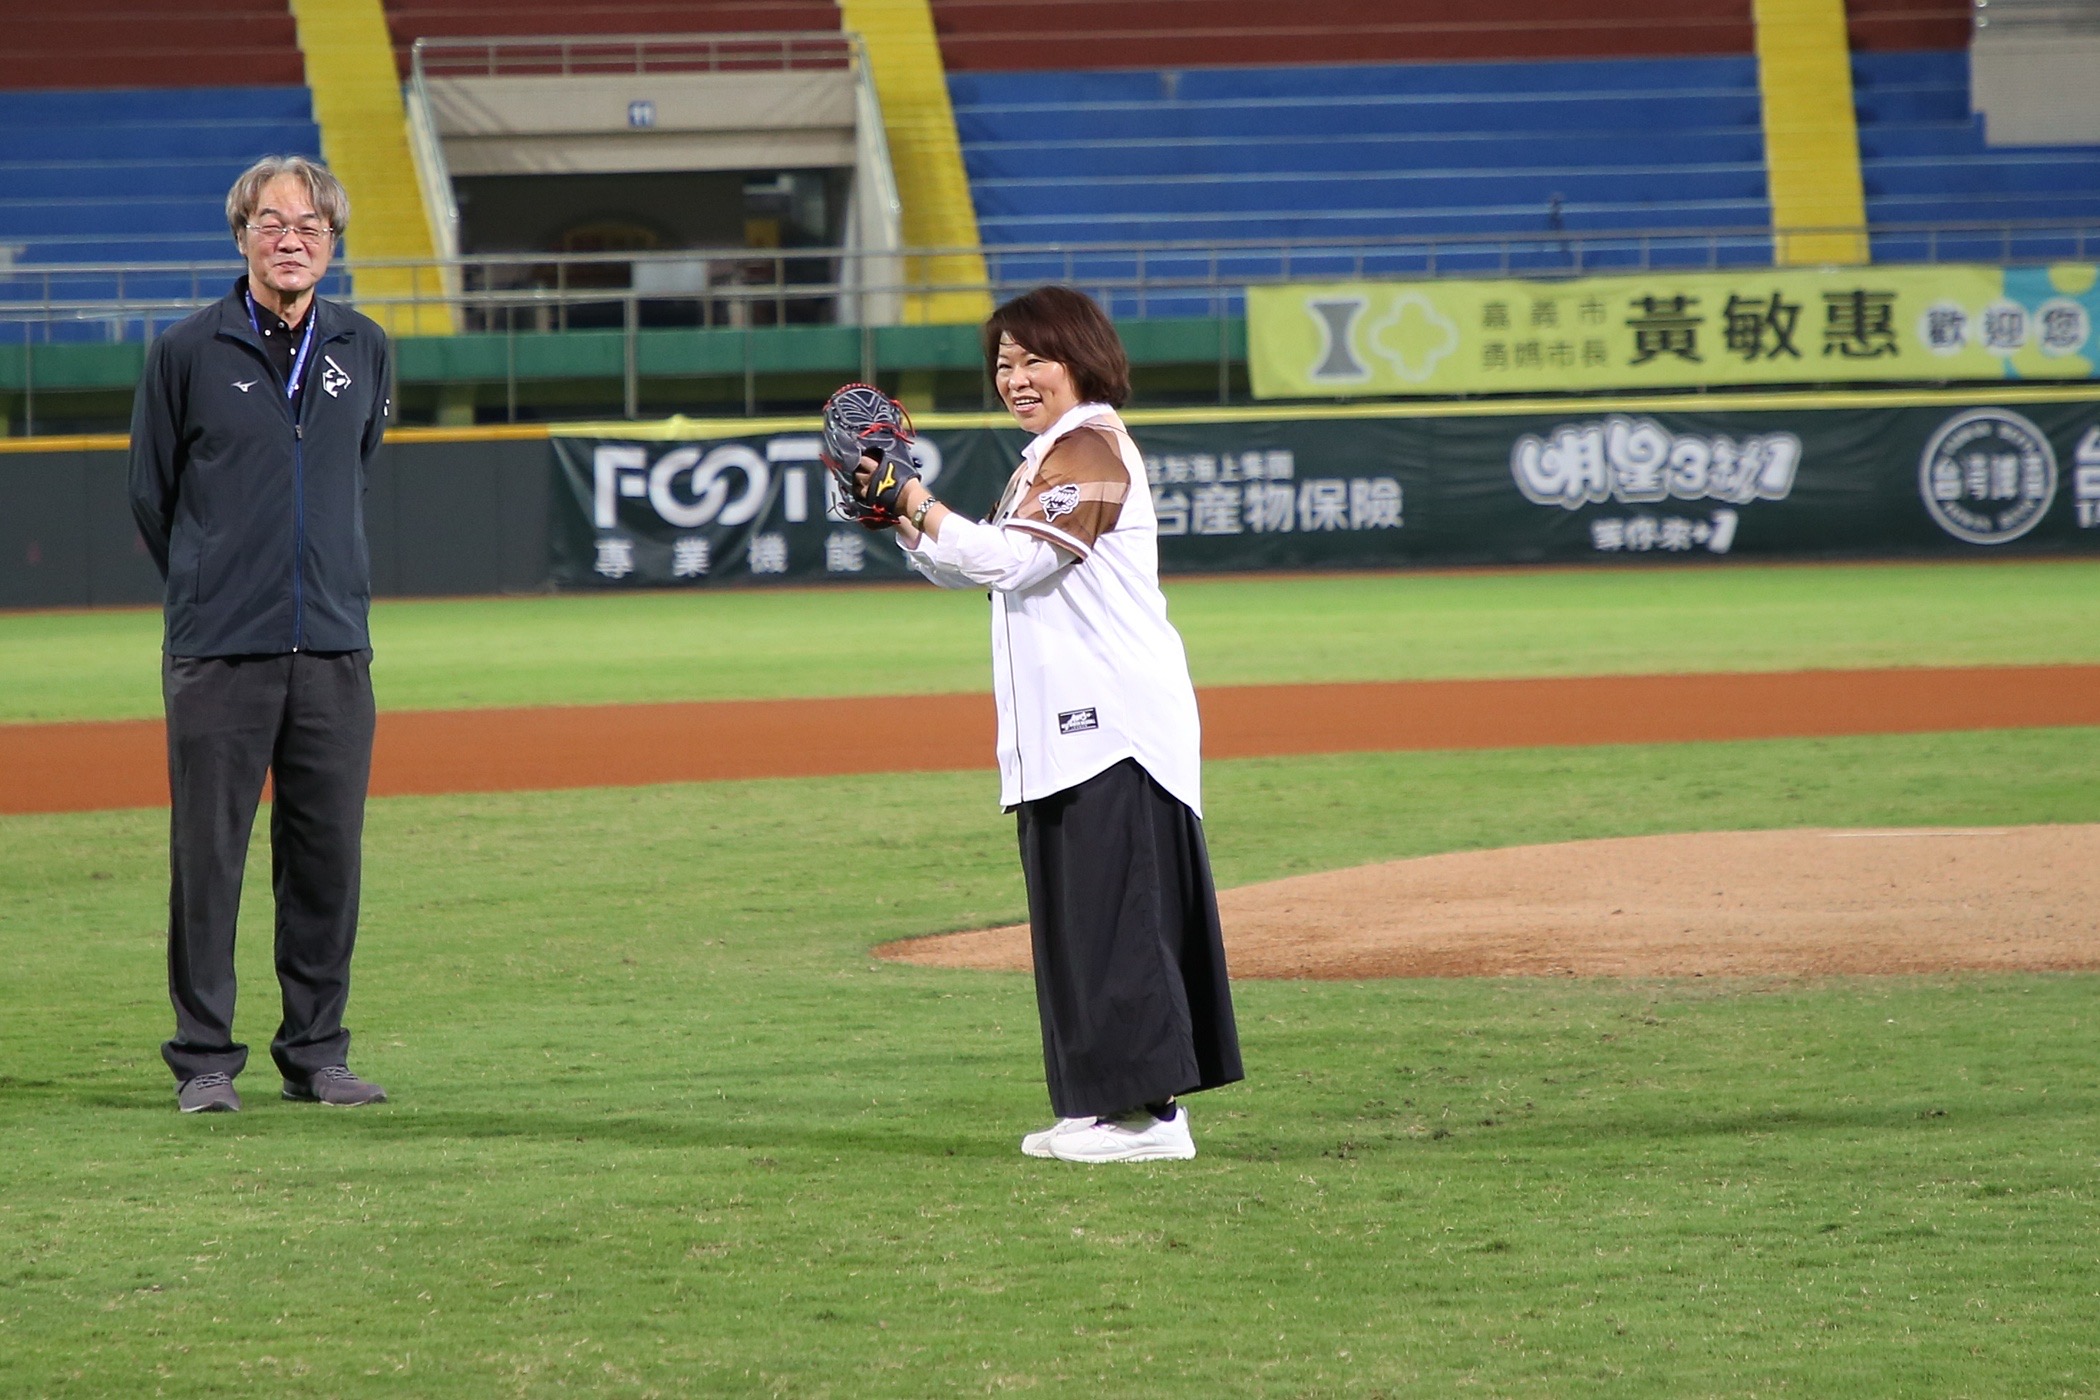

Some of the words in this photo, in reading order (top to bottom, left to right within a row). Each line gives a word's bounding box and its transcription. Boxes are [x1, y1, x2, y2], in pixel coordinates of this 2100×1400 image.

[1626, 289, 1900, 365] 黃敏惠
[1928, 307, 2083, 350] 歡迎您
